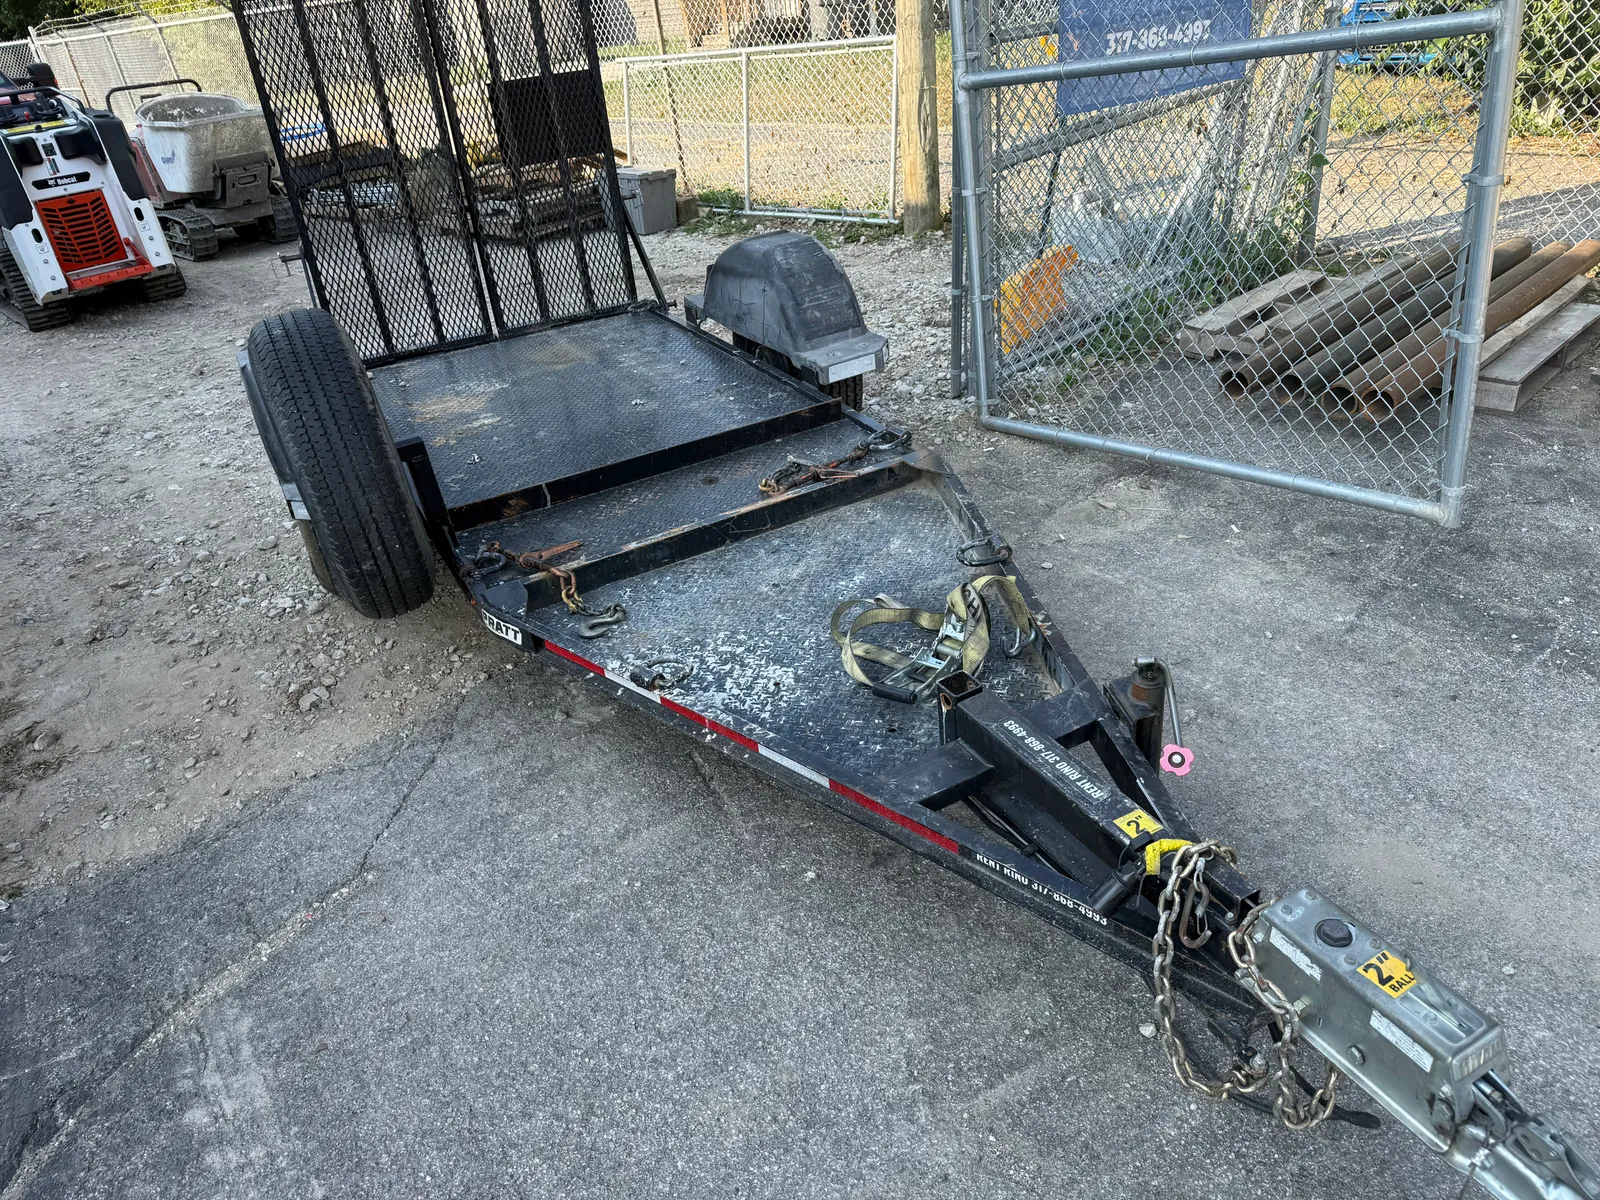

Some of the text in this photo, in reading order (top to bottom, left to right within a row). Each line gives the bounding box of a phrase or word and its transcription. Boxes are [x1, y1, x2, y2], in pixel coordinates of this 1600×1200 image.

[57, 176, 77, 185] Bobcat
[1003, 719, 1103, 798] RENT RINO 317-868-4993
[1362, 952, 1393, 985] 2"
[1389, 973, 1415, 993] BALL
